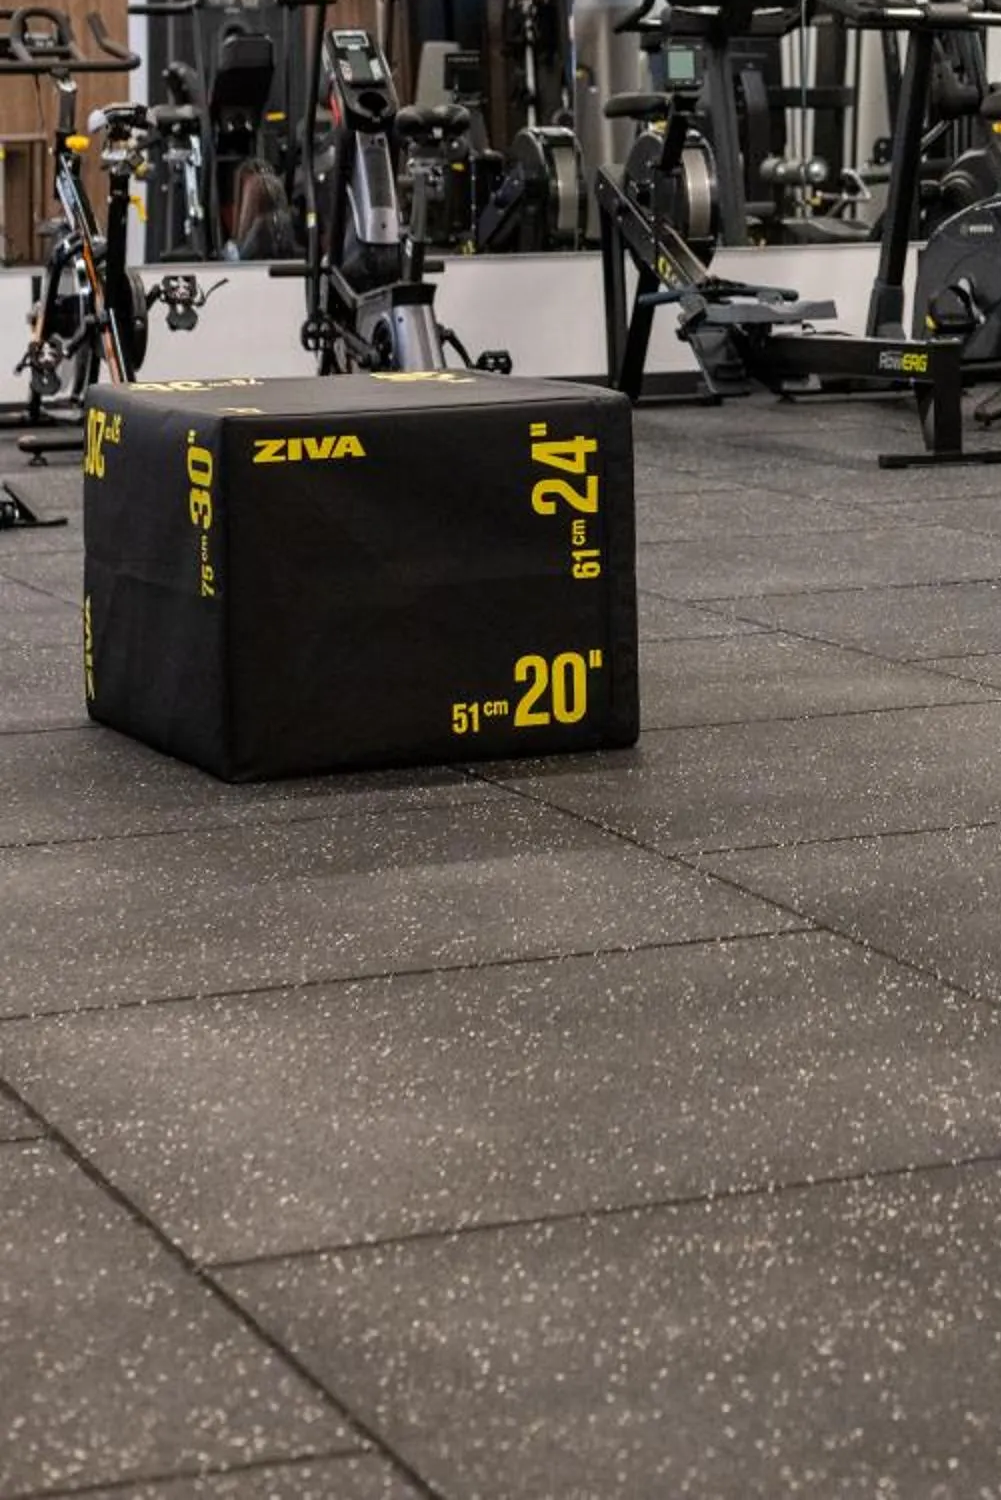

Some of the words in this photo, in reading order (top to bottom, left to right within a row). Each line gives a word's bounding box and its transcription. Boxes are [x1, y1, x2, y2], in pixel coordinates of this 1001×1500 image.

[253, 435, 367, 463] ZIVA
[187, 429, 213, 529] 30"
[530, 422, 599, 515] 24"
[571, 519, 586, 546] cm
[201, 564, 215, 597] 75
[572, 549, 601, 579] 61
[452, 701, 479, 734] 51
[483, 699, 509, 717] cm
[513, 649, 603, 727] 20"
